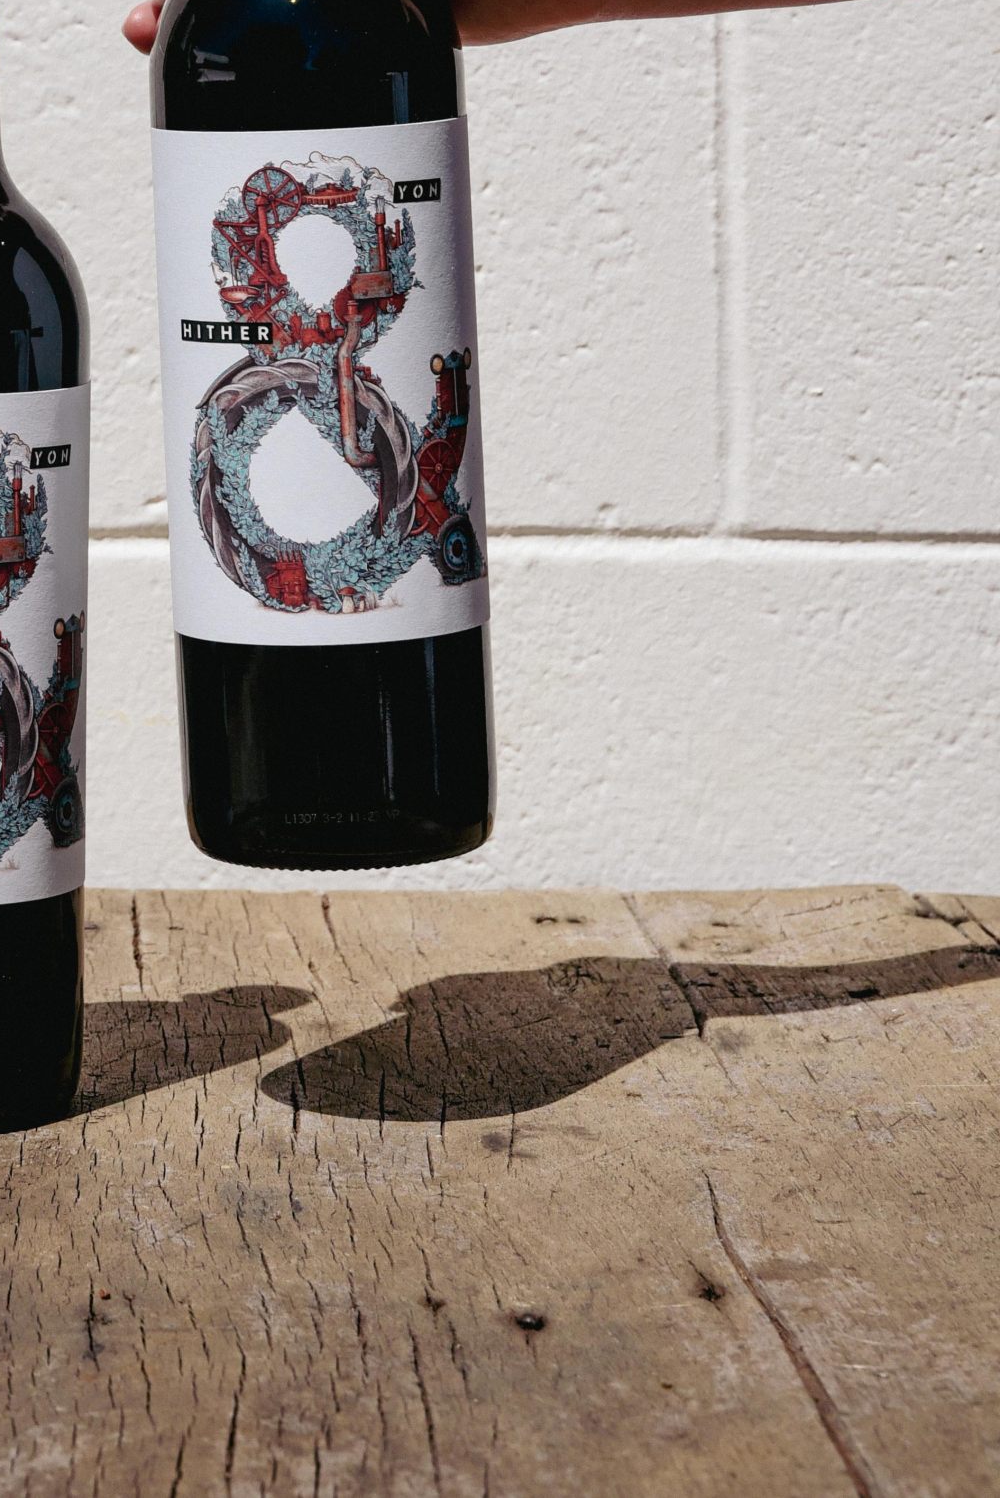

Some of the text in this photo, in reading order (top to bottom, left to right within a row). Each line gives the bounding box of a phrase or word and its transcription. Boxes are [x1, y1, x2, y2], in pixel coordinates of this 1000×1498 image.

[397, 182, 438, 200] YON
[183, 323, 269, 341] HITHER
[34, 447, 69, 466] YON
